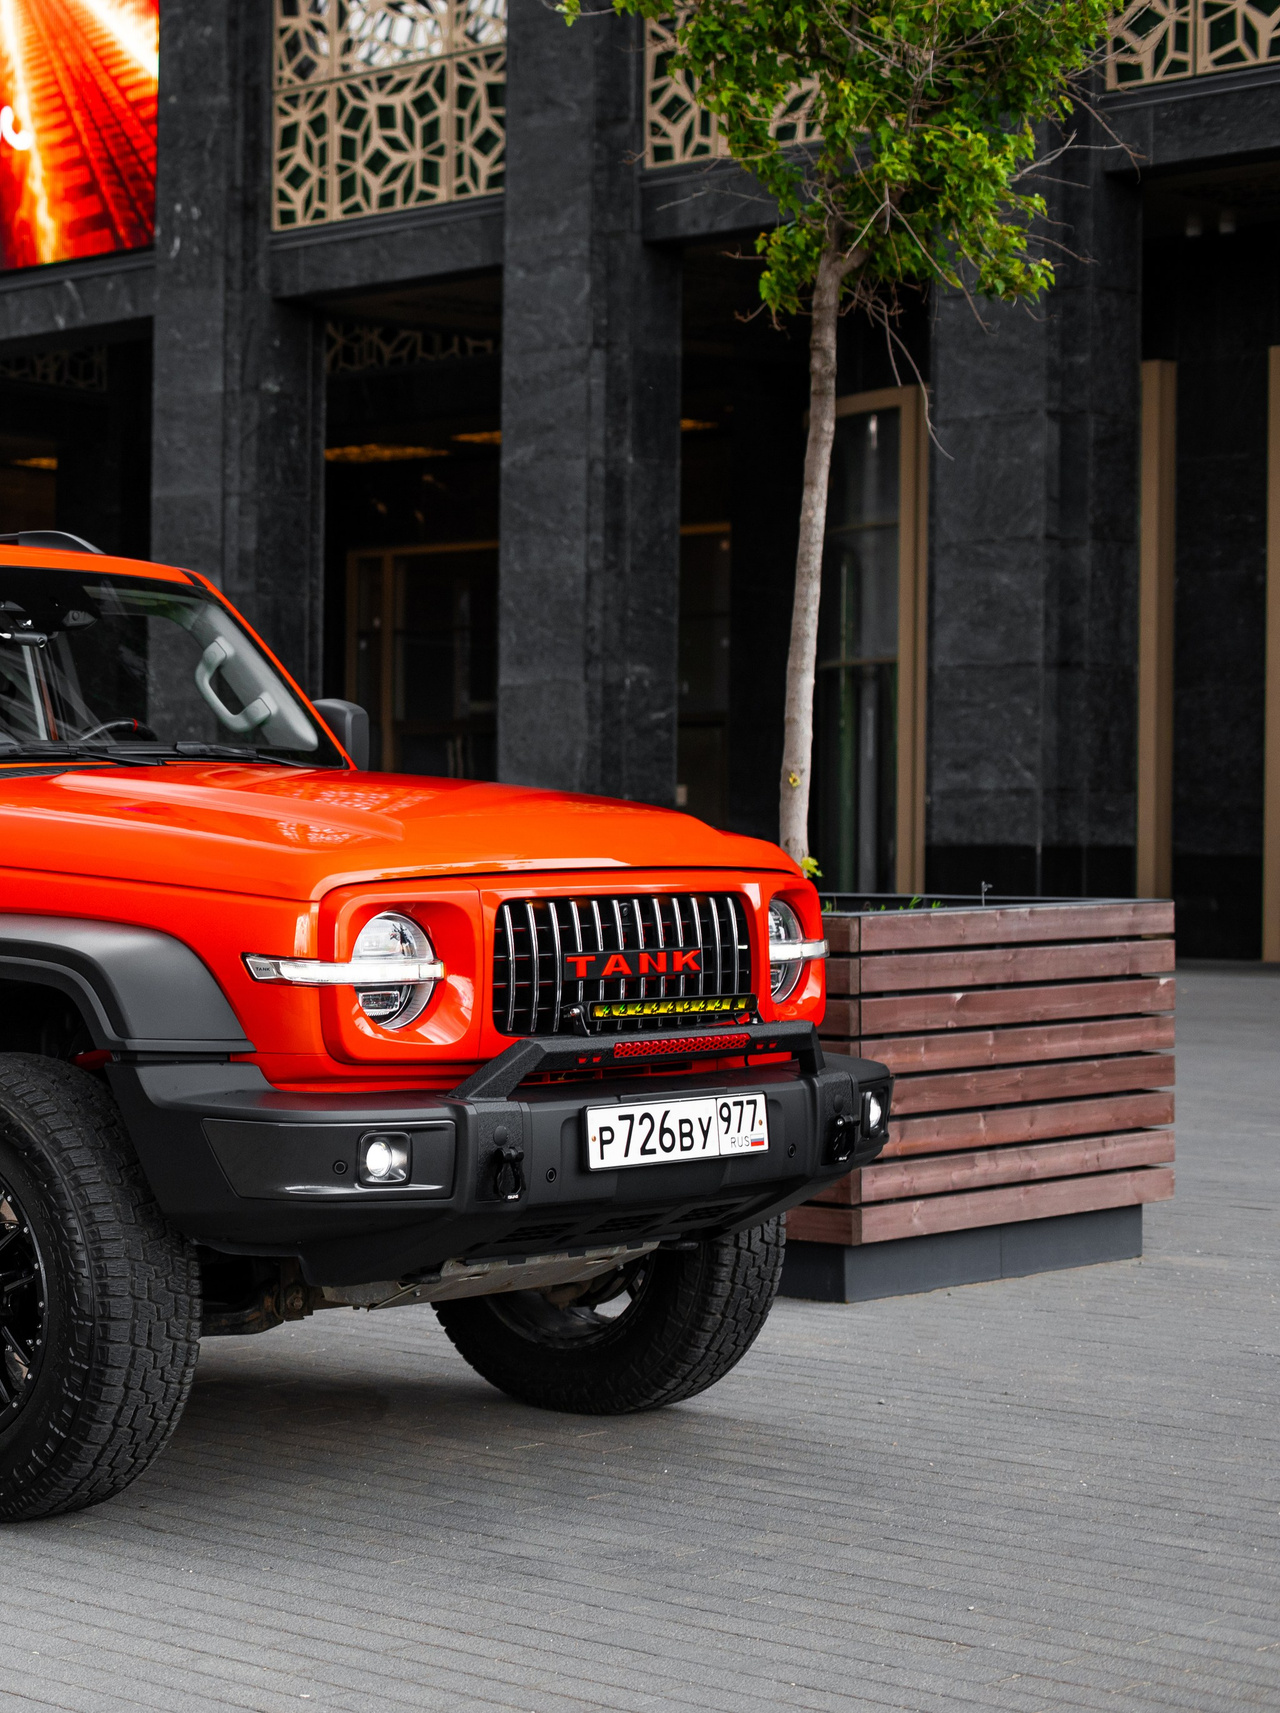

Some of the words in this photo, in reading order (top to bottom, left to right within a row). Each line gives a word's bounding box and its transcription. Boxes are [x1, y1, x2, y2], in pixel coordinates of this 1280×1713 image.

[566, 950, 701, 978] TANK
[720, 1099, 758, 1135] 977
[730, 1135, 750, 1148] RUS
